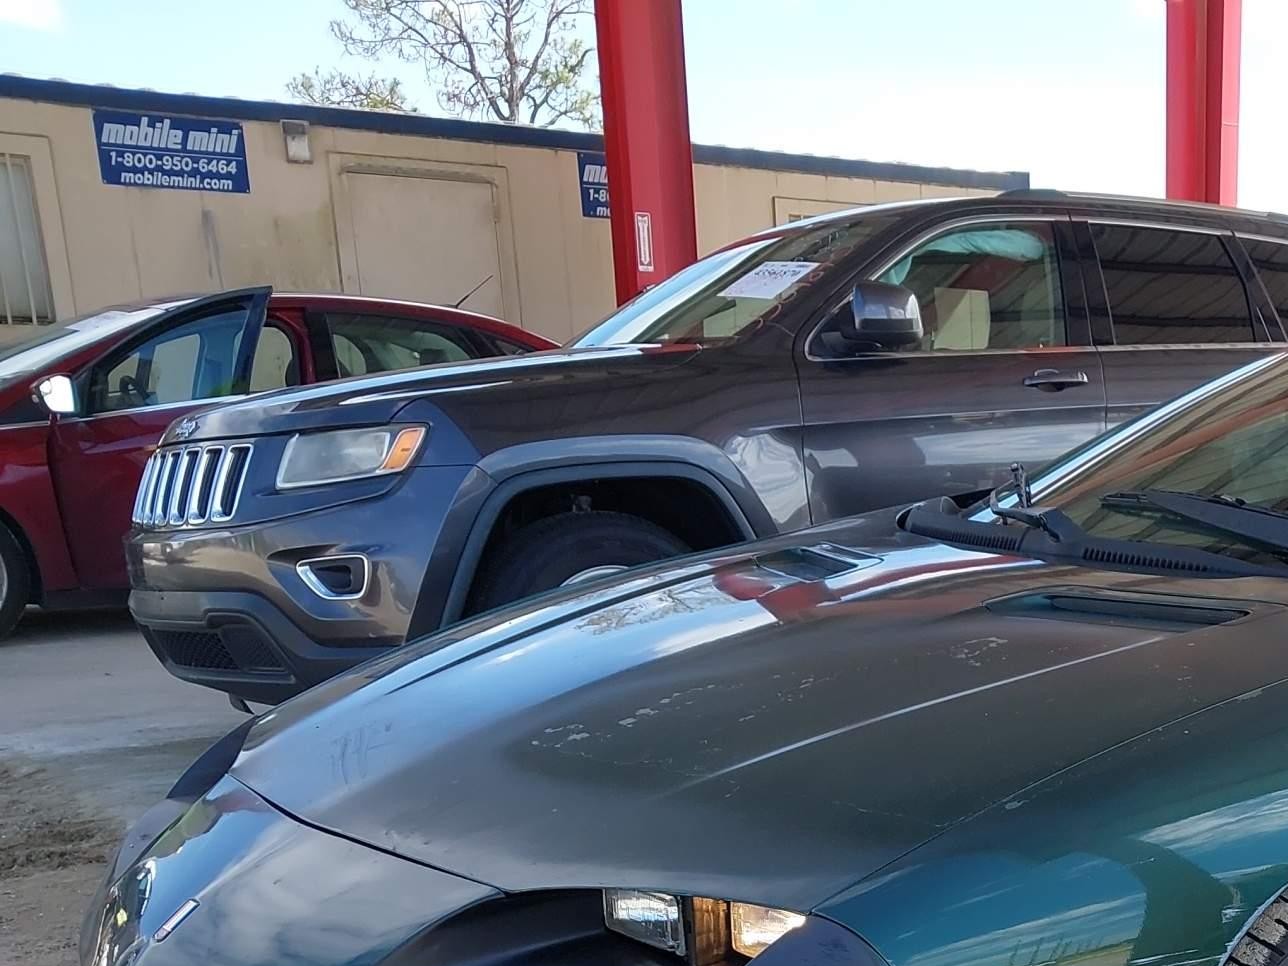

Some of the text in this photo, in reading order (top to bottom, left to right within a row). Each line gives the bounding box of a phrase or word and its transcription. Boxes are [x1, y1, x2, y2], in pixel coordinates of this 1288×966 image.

[101, 117, 239, 153] mobile mini
[110, 151, 237, 174] 1-800-950-6464
[120, 171, 232, 190] mobilemini.com
